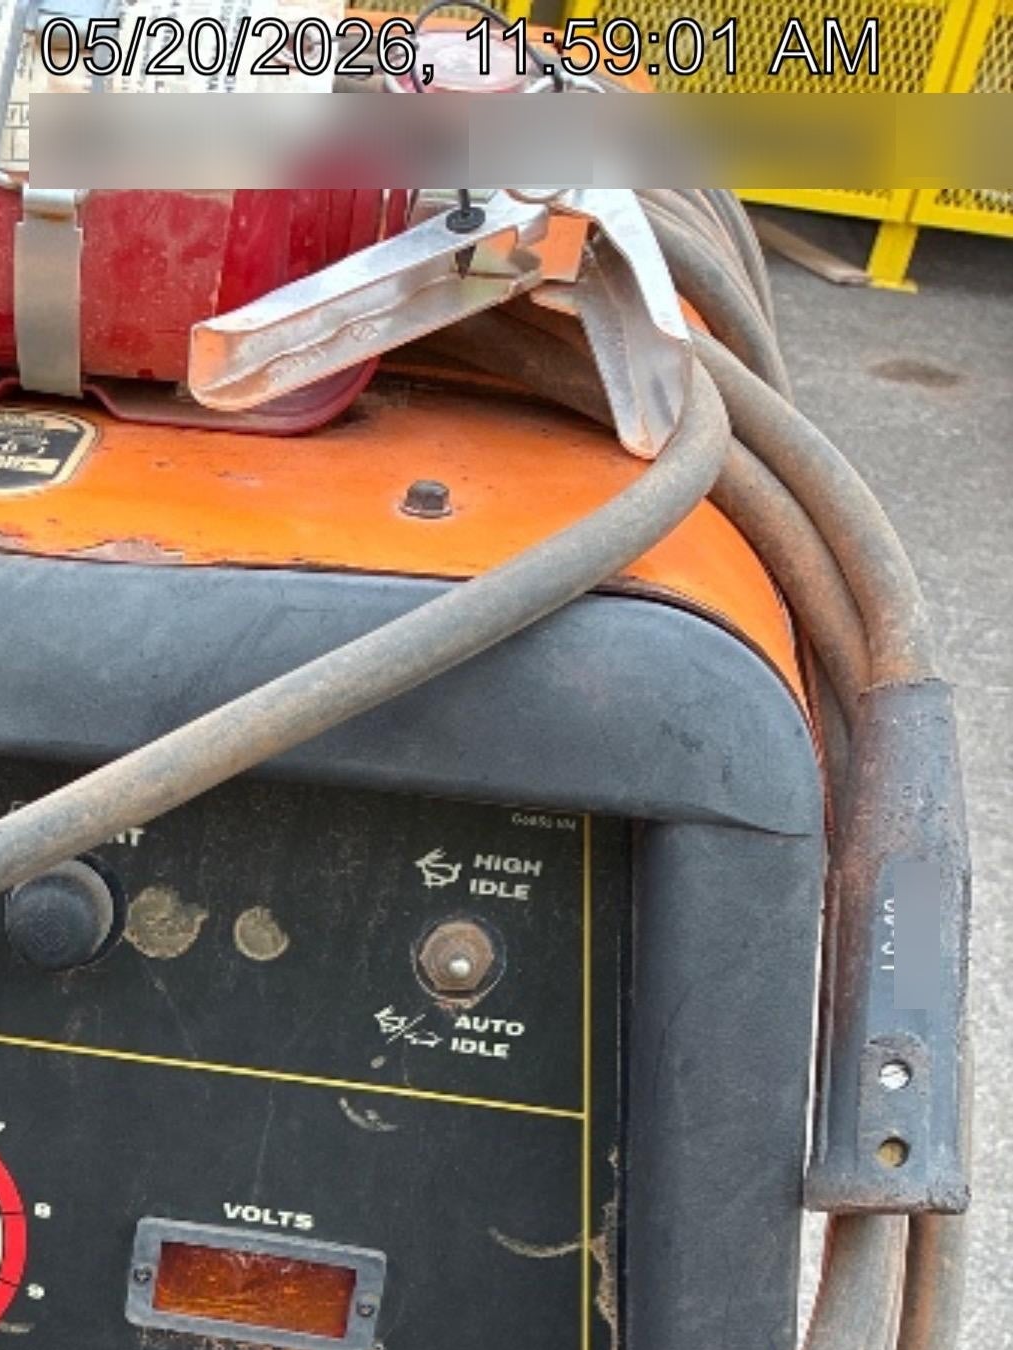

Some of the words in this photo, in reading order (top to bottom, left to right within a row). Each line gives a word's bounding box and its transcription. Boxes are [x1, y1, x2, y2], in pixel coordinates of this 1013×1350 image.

[472, 853, 544, 877] HIGH
[469, 878, 531, 900] IDLE
[454, 1014, 526, 1037] AUTO
[450, 1037, 511, 1059] IDLE
[222, 1202, 316, 1231] VOLTS
